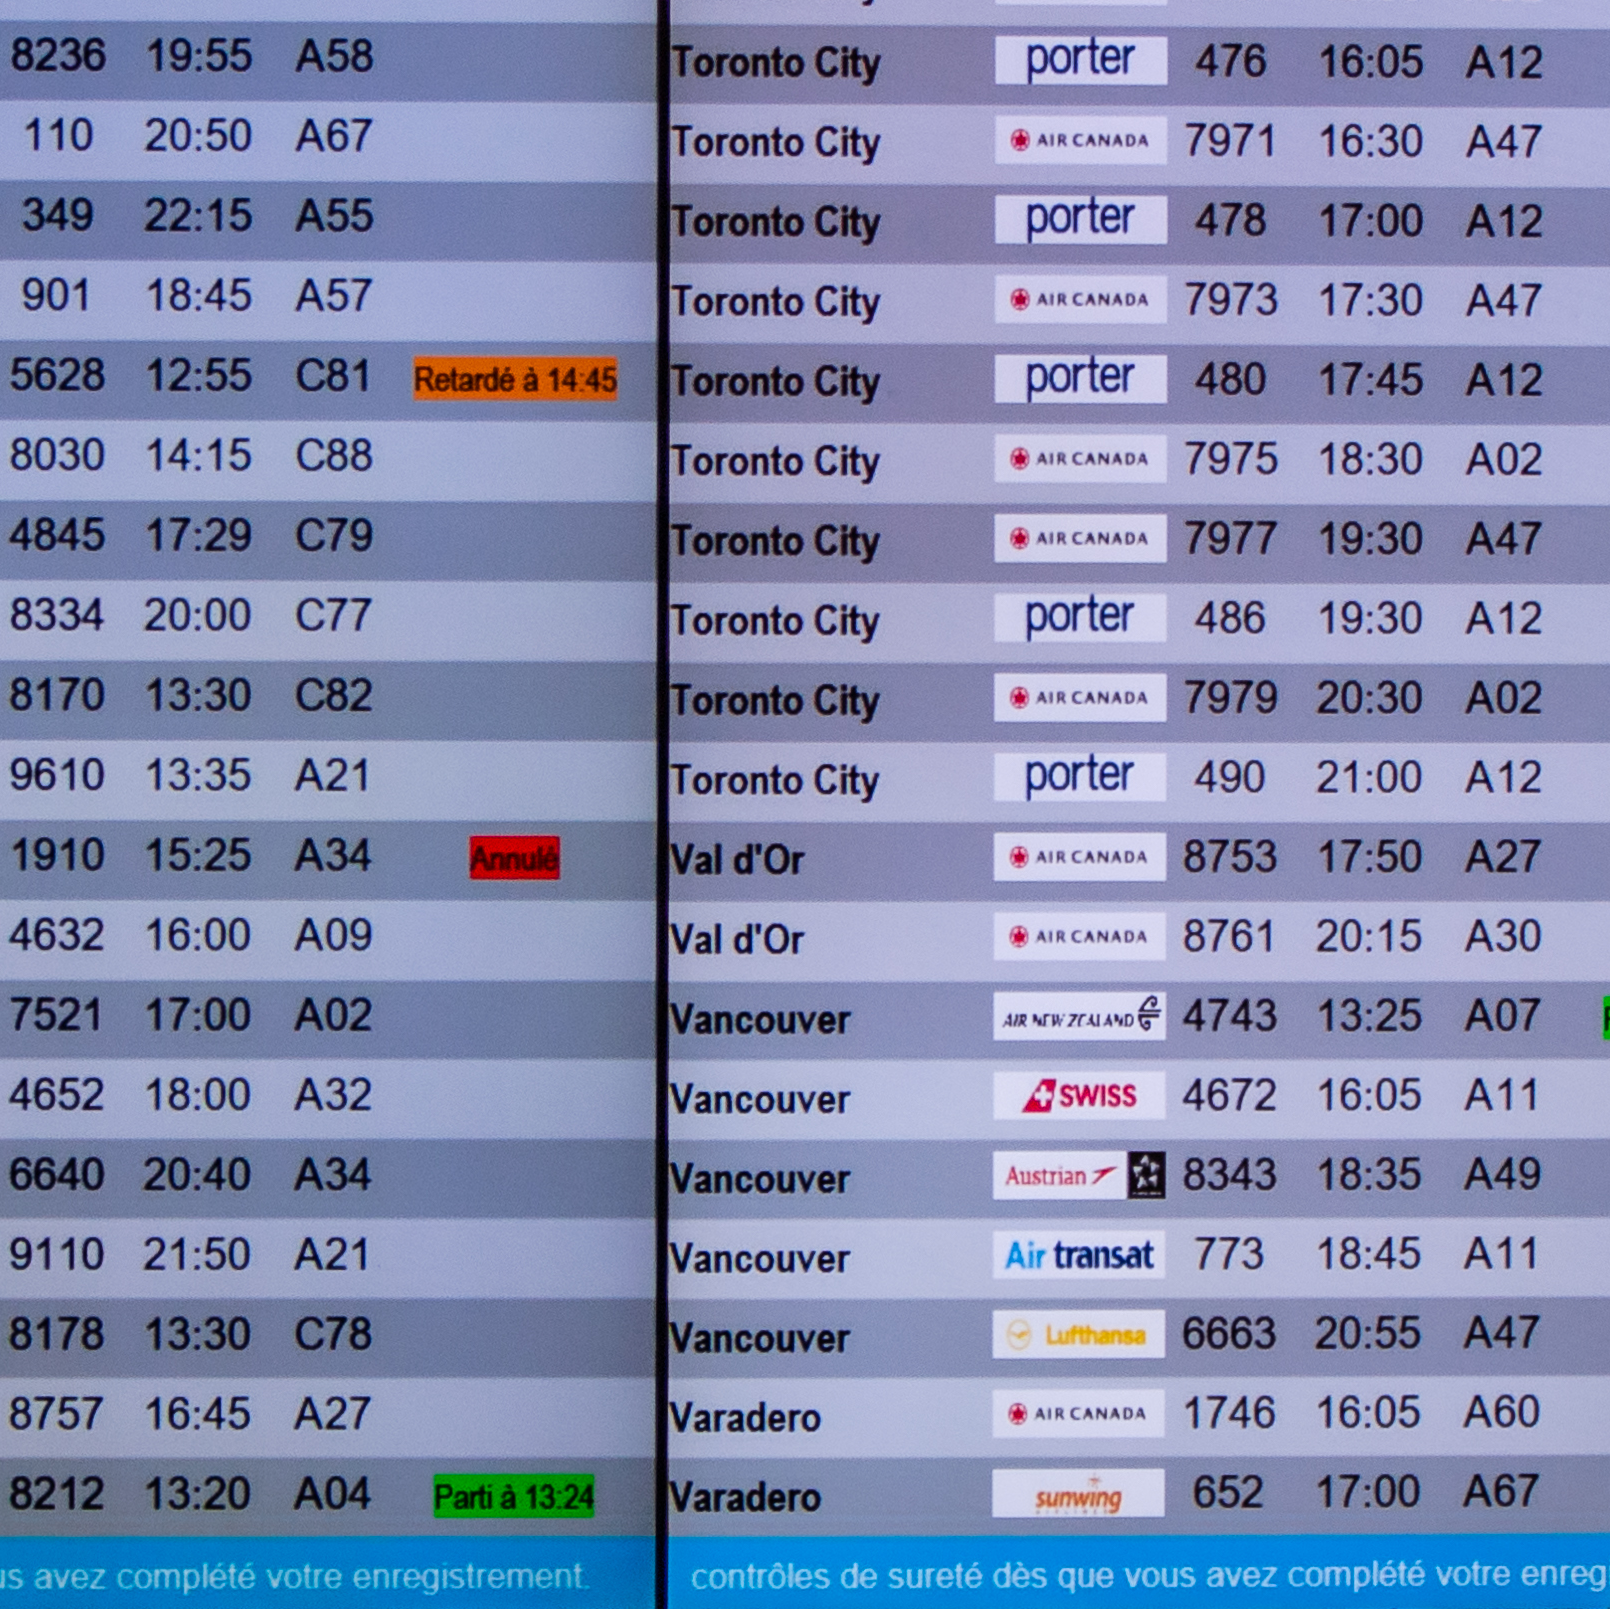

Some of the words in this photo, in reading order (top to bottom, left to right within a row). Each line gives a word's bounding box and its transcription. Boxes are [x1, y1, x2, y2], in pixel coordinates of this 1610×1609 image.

[11, 357, 105, 391] 5628
[148, 357, 252, 391] 12:55
[297, 358, 367, 391] C81
[416, 366, 515, 395] Retardé
[523, 367, 538, 392] à
[549, 366, 617, 395] 14:45
[13, 837, 104, 871] 1910
[147, 837, 251, 871] 15:25
[295, 837, 371, 871] A34
[470, 845, 559, 871] Annulé
[669, 1084, 850, 1114] Vancouver
[1060, 1084, 1137, 1107] SWISS
[1183, 1078, 1276, 1111] 4672
[1320, 1077, 1421, 1111] 16:05
[1465, 1077, 1535, 1110] A11
[10, 1396, 103, 1430] 8757
[147, 1396, 250, 1430] 16:45
[294, 1396, 371, 1430] A27
[669, 1481, 821, 1514] Varadero
[1035, 1491, 1122, 1514] sunwing
[1194, 1475, 1263, 1508] 652
[1318, 1474, 1420, 1508] 17:00
[1463, 1473, 1539, 1507] A67
[34, 1567, 107, 1590] avez
[116, 1561, 257, 1596] complété
[265, 1562, 343, 1589] votre
[352, 1562, 589, 1595] enregistrement.
